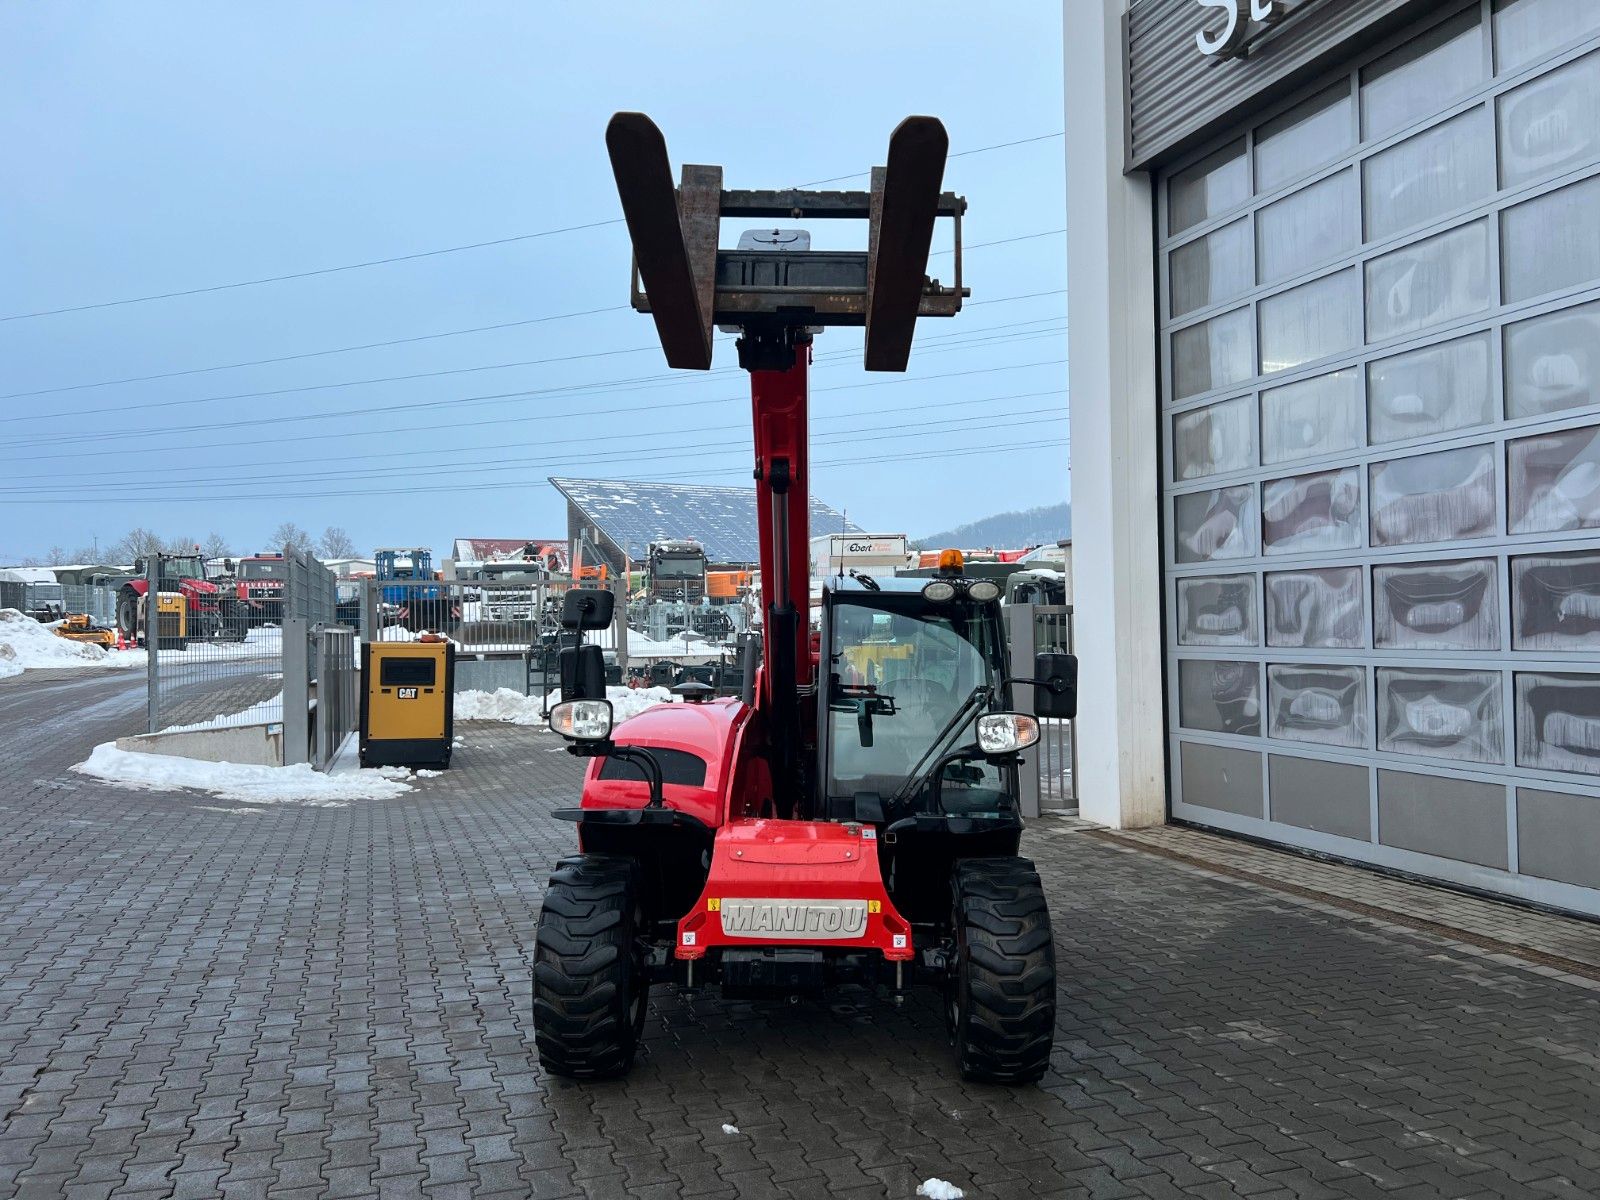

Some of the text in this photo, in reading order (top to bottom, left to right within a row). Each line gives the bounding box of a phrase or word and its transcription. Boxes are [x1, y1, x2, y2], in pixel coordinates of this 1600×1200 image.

[1196, 0, 1273, 55] S
[850, 543, 872, 552] Ebert
[399, 688, 416, 698] CAT
[725, 905, 865, 933] MANITOU
